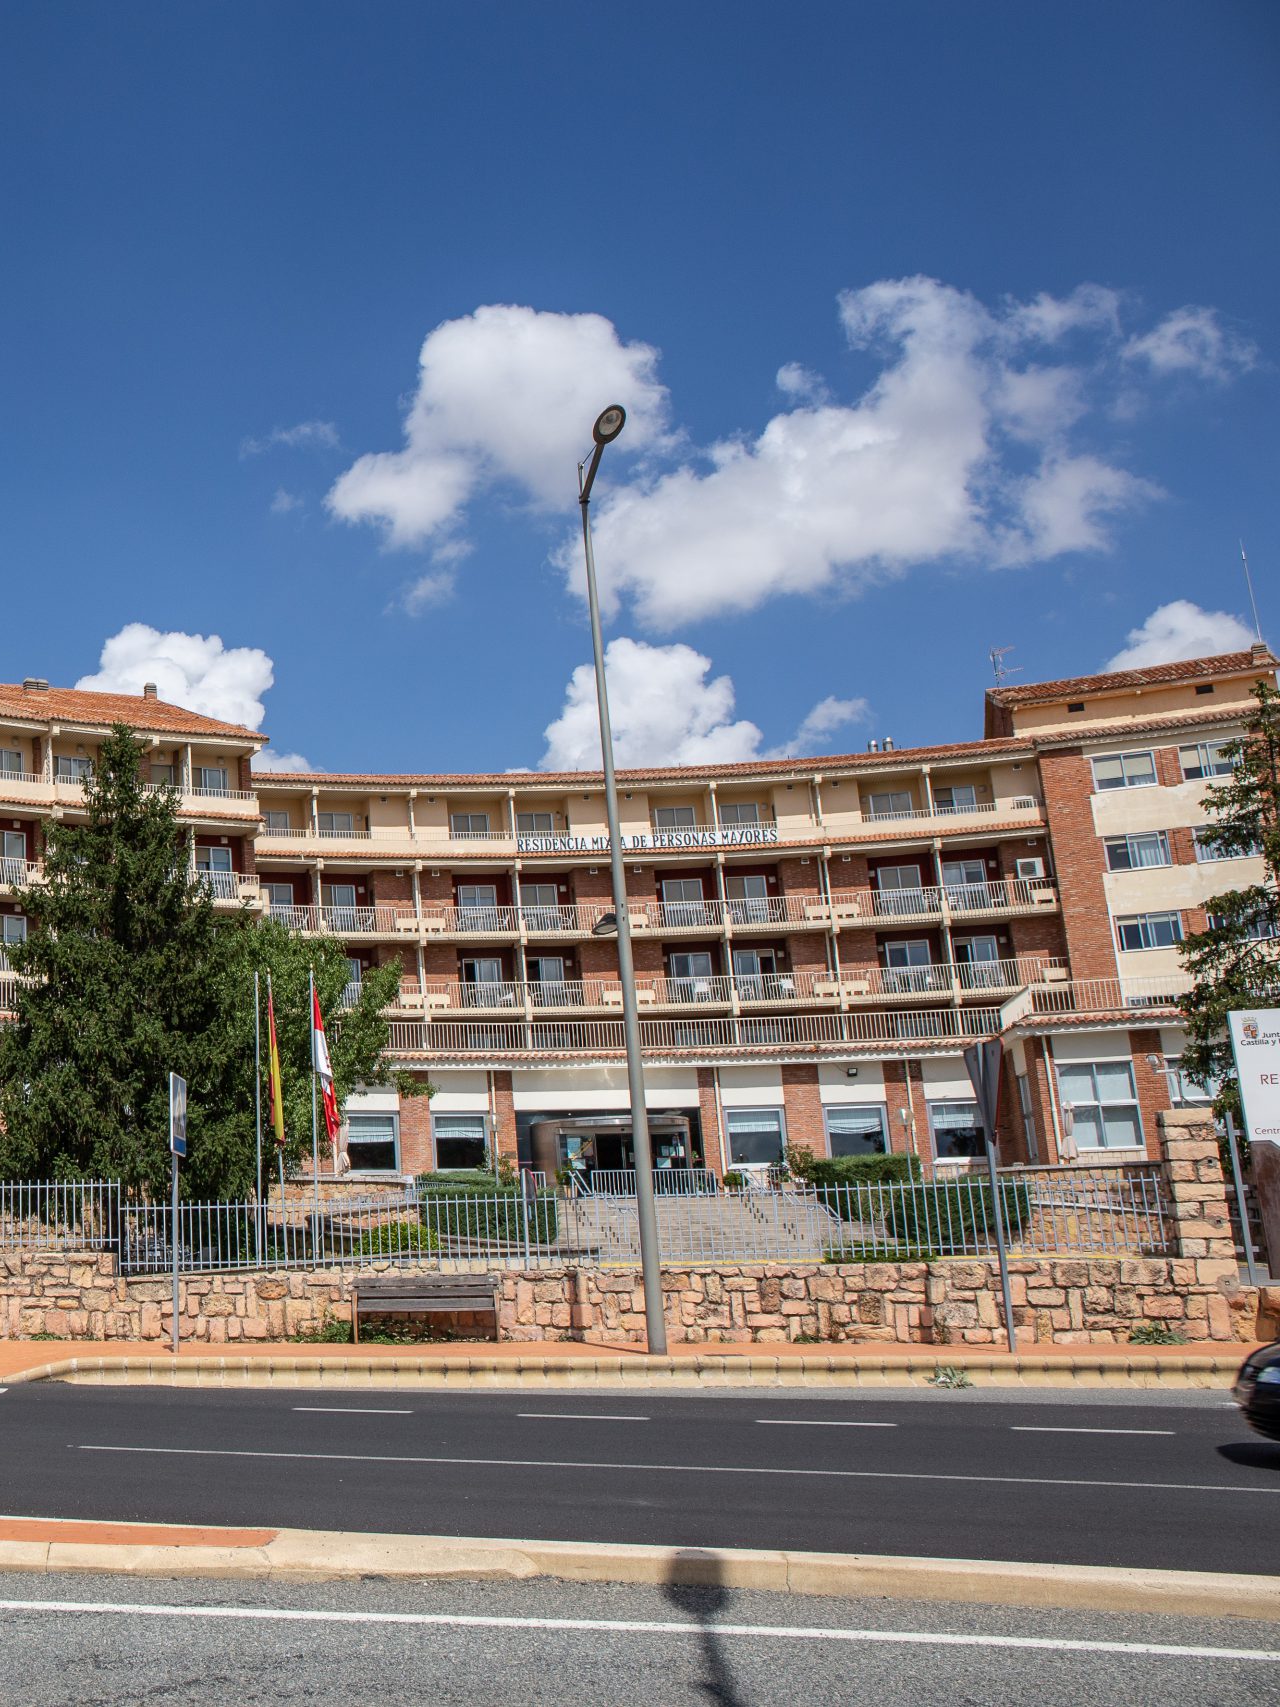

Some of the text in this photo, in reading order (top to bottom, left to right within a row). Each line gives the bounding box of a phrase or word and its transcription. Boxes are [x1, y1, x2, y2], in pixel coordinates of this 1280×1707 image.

[517, 829, 778, 852] RESIDENCIA MIXA DE PERSONAS MAYORES
[1240, 1038, 1269, 1046] Castilla
[1260, 1073, 1280, 1085] RE
